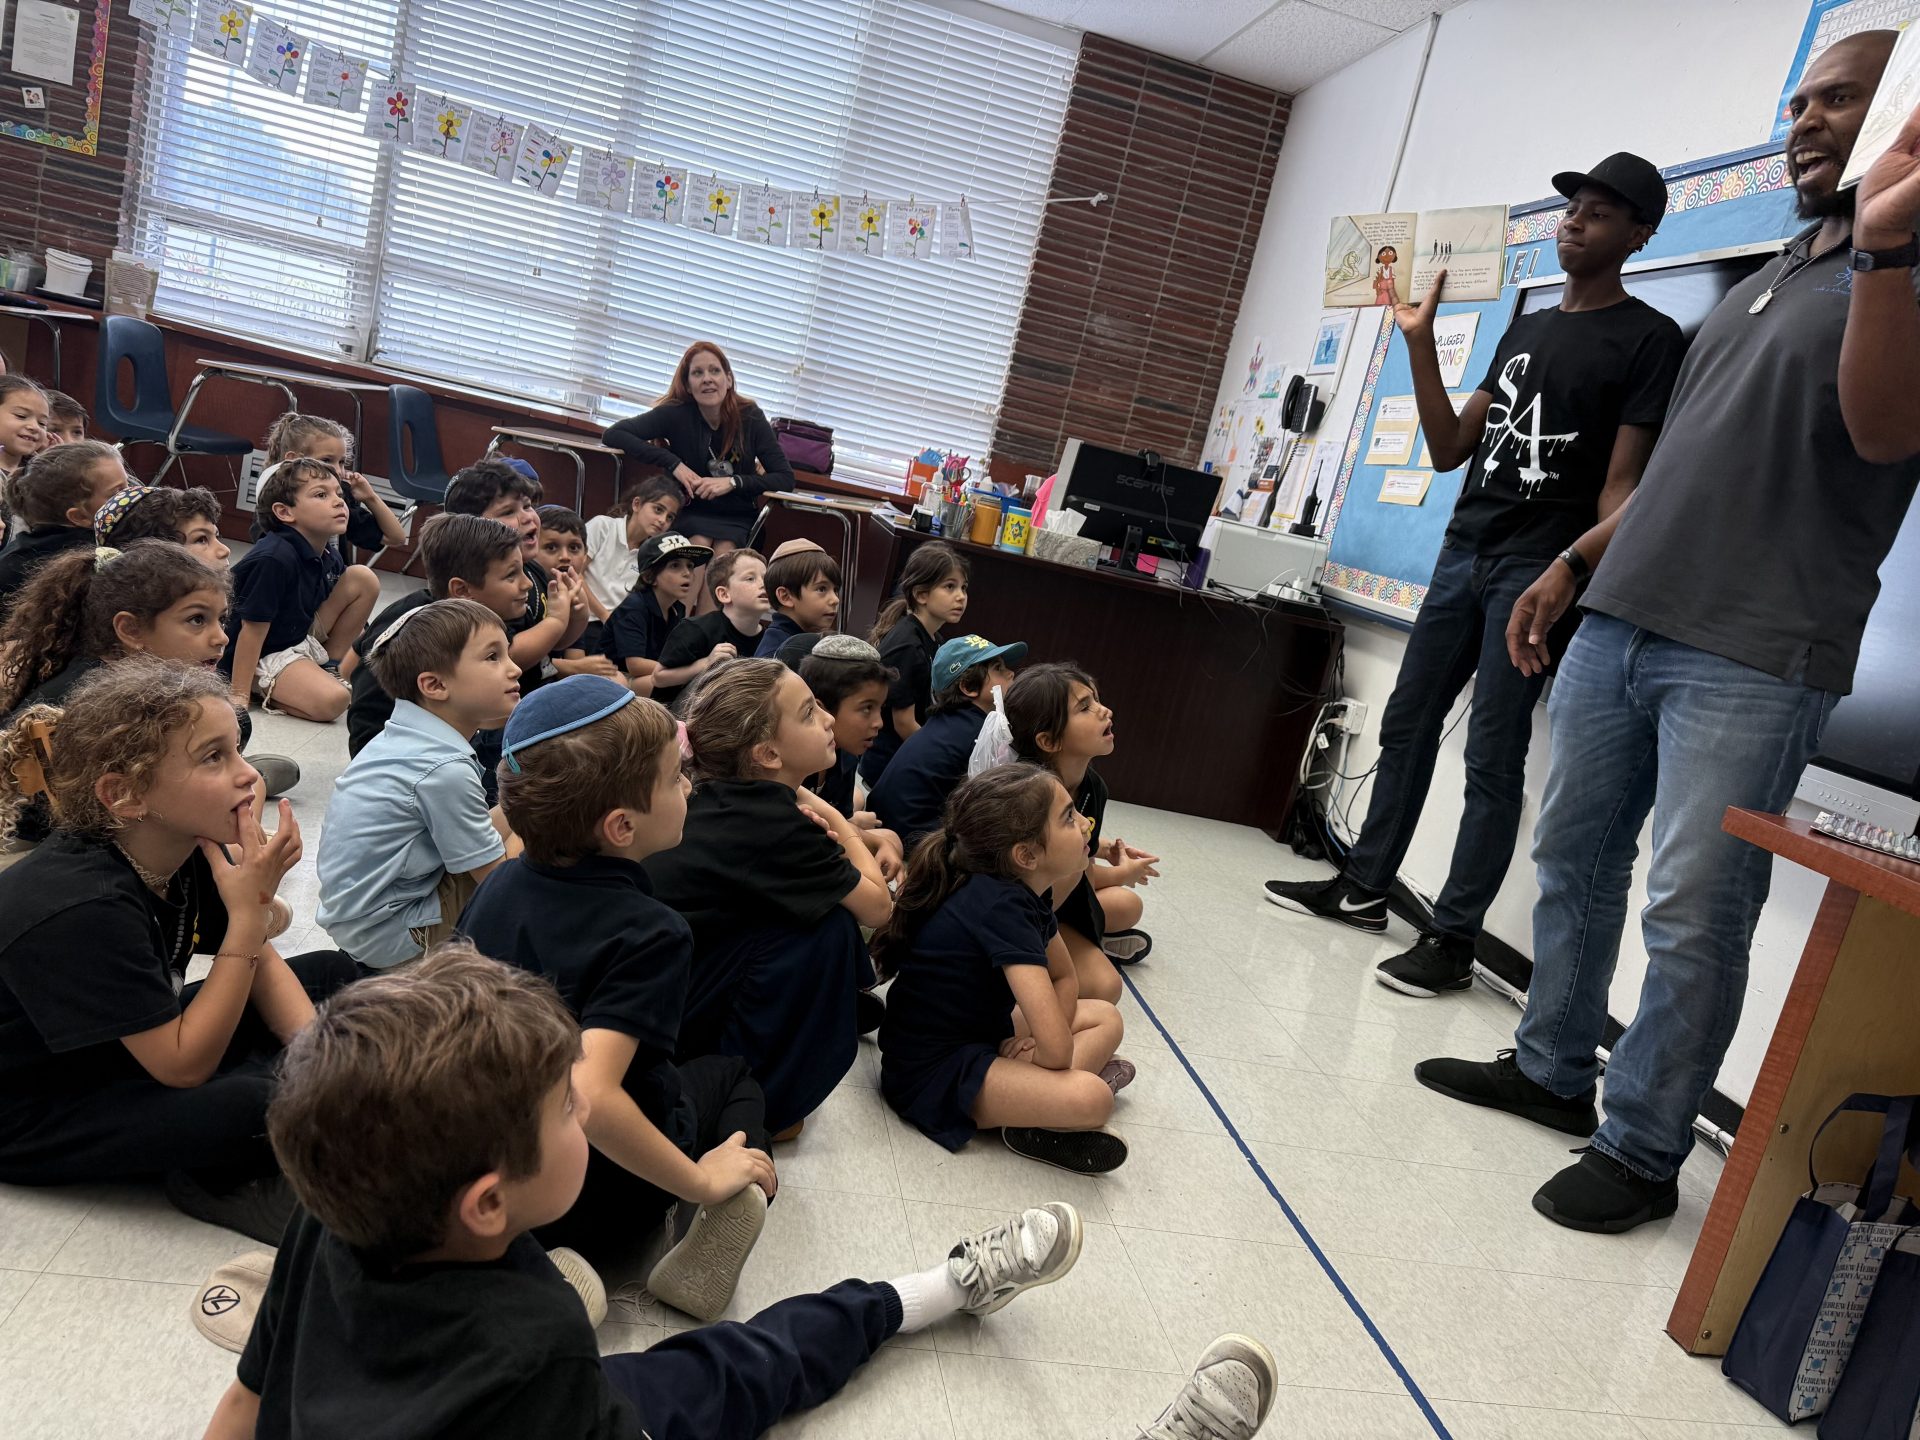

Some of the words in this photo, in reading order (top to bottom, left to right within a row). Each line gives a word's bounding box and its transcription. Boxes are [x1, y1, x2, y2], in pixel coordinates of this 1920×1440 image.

[1435, 333, 1466, 347] PLUGGED
[1438, 348, 1465, 367] DING
[1116, 474, 1176, 496] SCEPTRE
[1808, 1337, 1836, 1348] HEBREW
[1797, 1374, 1827, 1385] HEBREW
[1794, 1383, 1826, 1394] ACADEMY
